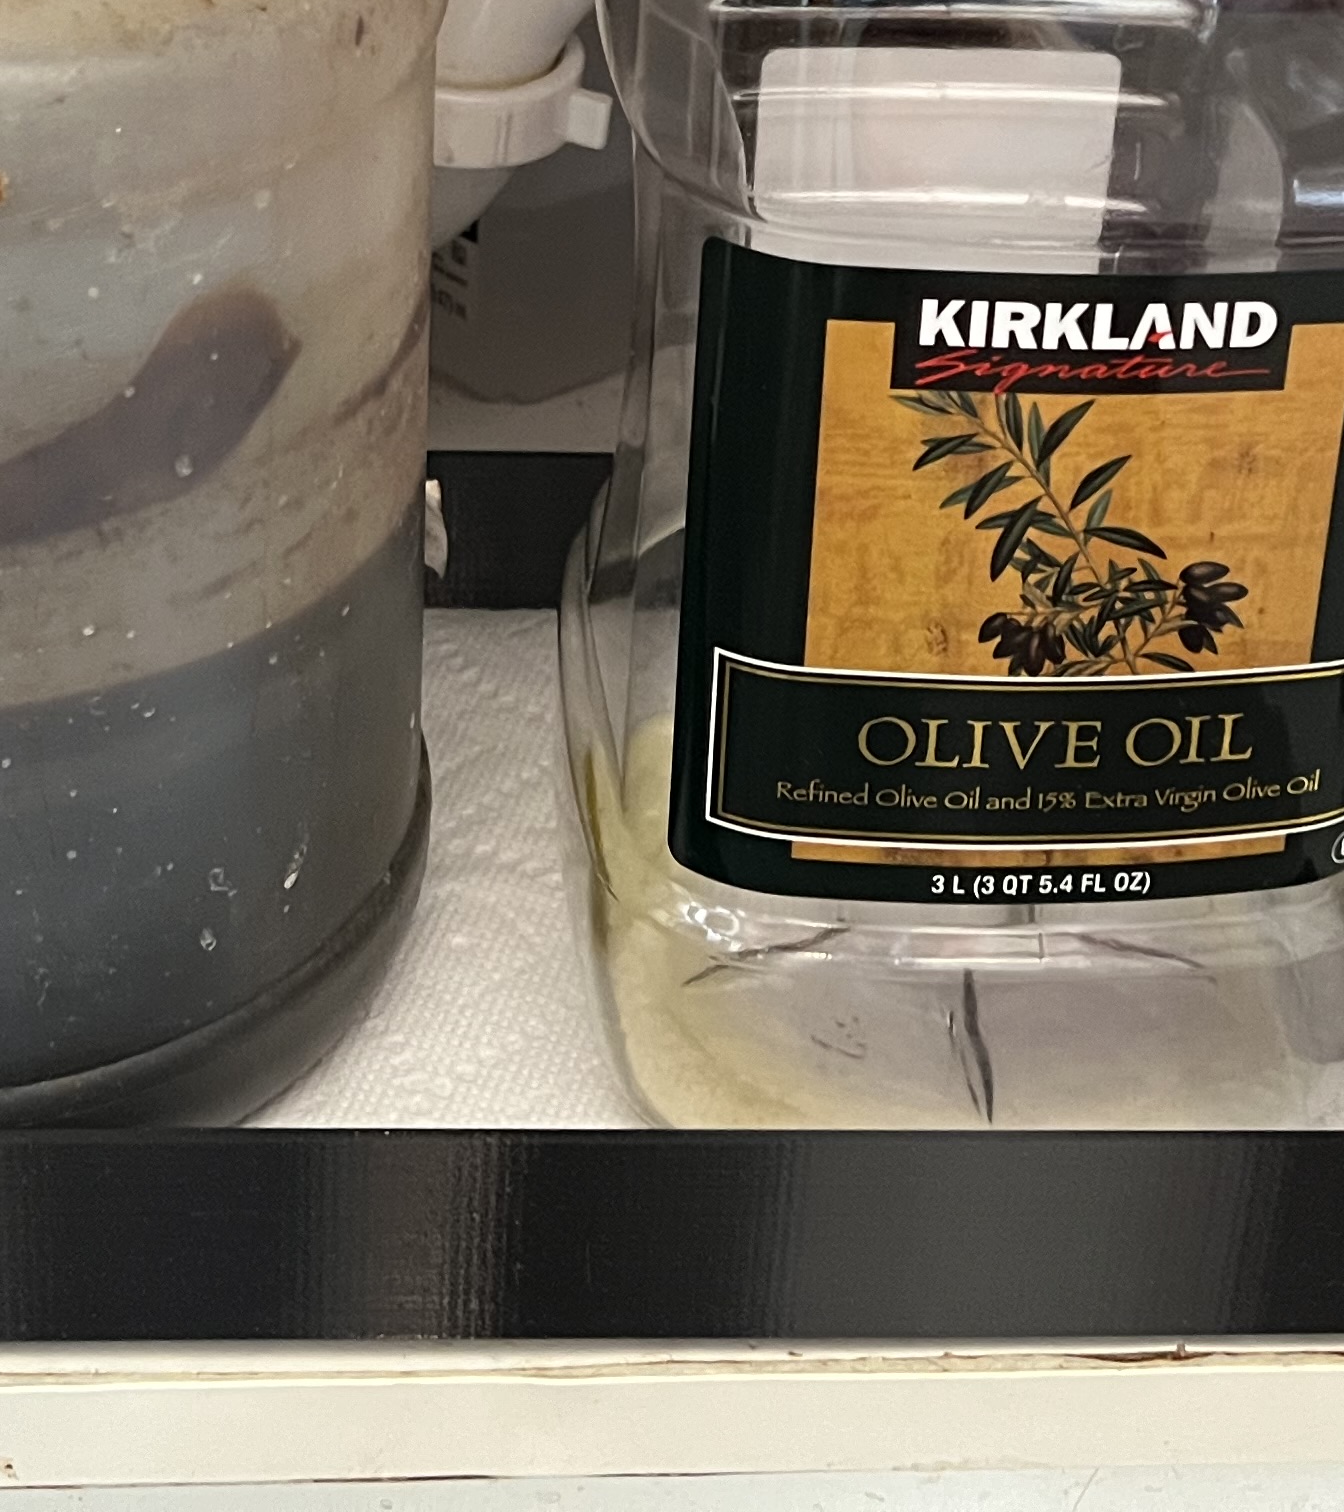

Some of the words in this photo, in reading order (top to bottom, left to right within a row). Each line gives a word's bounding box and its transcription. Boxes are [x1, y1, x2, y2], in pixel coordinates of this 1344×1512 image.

[919, 298, 1278, 351] KIRKLAND
[915, 349, 1270, 394] Signature
[858, 716, 1102, 770] OLIVE
[1126, 712, 1252, 767] OIL
[776, 779, 869, 805] Refined
[876, 784, 937, 809] Olive
[944, 787, 980, 809] Oil
[986, 787, 1031, 810] and
[1039, 791, 1076, 812] 15%
[1085, 791, 1147, 809] Extra
[1155, 787, 1216, 813] Virgin
[1223, 777, 1281, 801] Olive
[1287, 768, 1321, 795] Oil
[932, 875, 944, 893] 3
[953, 876, 965, 893] L
[974, 874, 995, 899] (3
[1003, 874, 1033, 894] QT
[1039, 874, 1073, 893] 5.4
[1082, 874, 1105, 892] FL
[1114, 871, 1150, 894] OZ)
